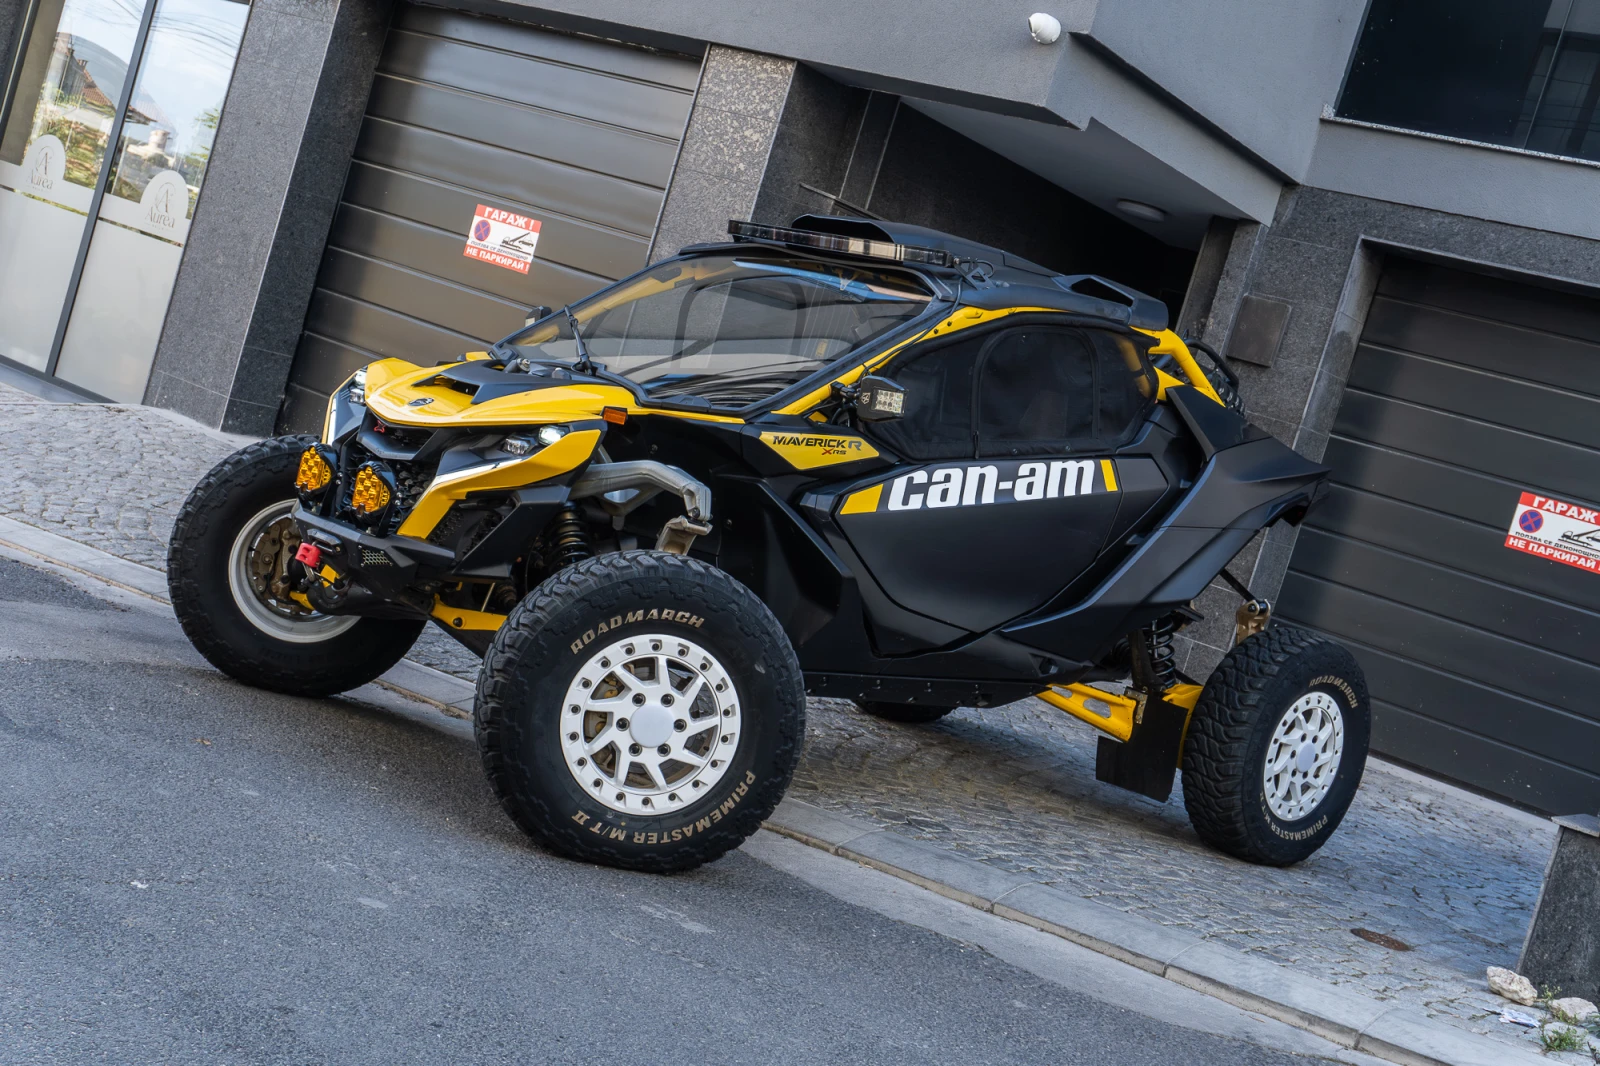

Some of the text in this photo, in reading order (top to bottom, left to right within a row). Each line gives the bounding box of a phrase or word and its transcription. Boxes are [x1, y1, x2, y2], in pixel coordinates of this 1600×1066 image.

[145, 206, 176, 228] Aurea
[484, 206, 528, 229] ГАРАЖ
[466, 246, 478, 256] НЕ
[479, 250, 525, 271] ПАРКИРАЙ
[772, 435, 863, 452] MAVERICK R
[821, 447, 847, 456] XRS
[887, 459, 1096, 512] can-am
[1532, 495, 1599, 524] ГАРАЖ
[1515, 531, 1543, 543] ПОЛЗВА
[1508, 536, 1597, 570] НЕ ПАРКИРАЙ
[570, 608, 705, 655] ROADMARCH
[1309, 675, 1359, 709] ROADMARCH
[633, 770, 756, 844] PRIMEMASTER
[589, 821, 627, 842] M/T
[1271, 814, 1328, 841] PRIMEMASTER
